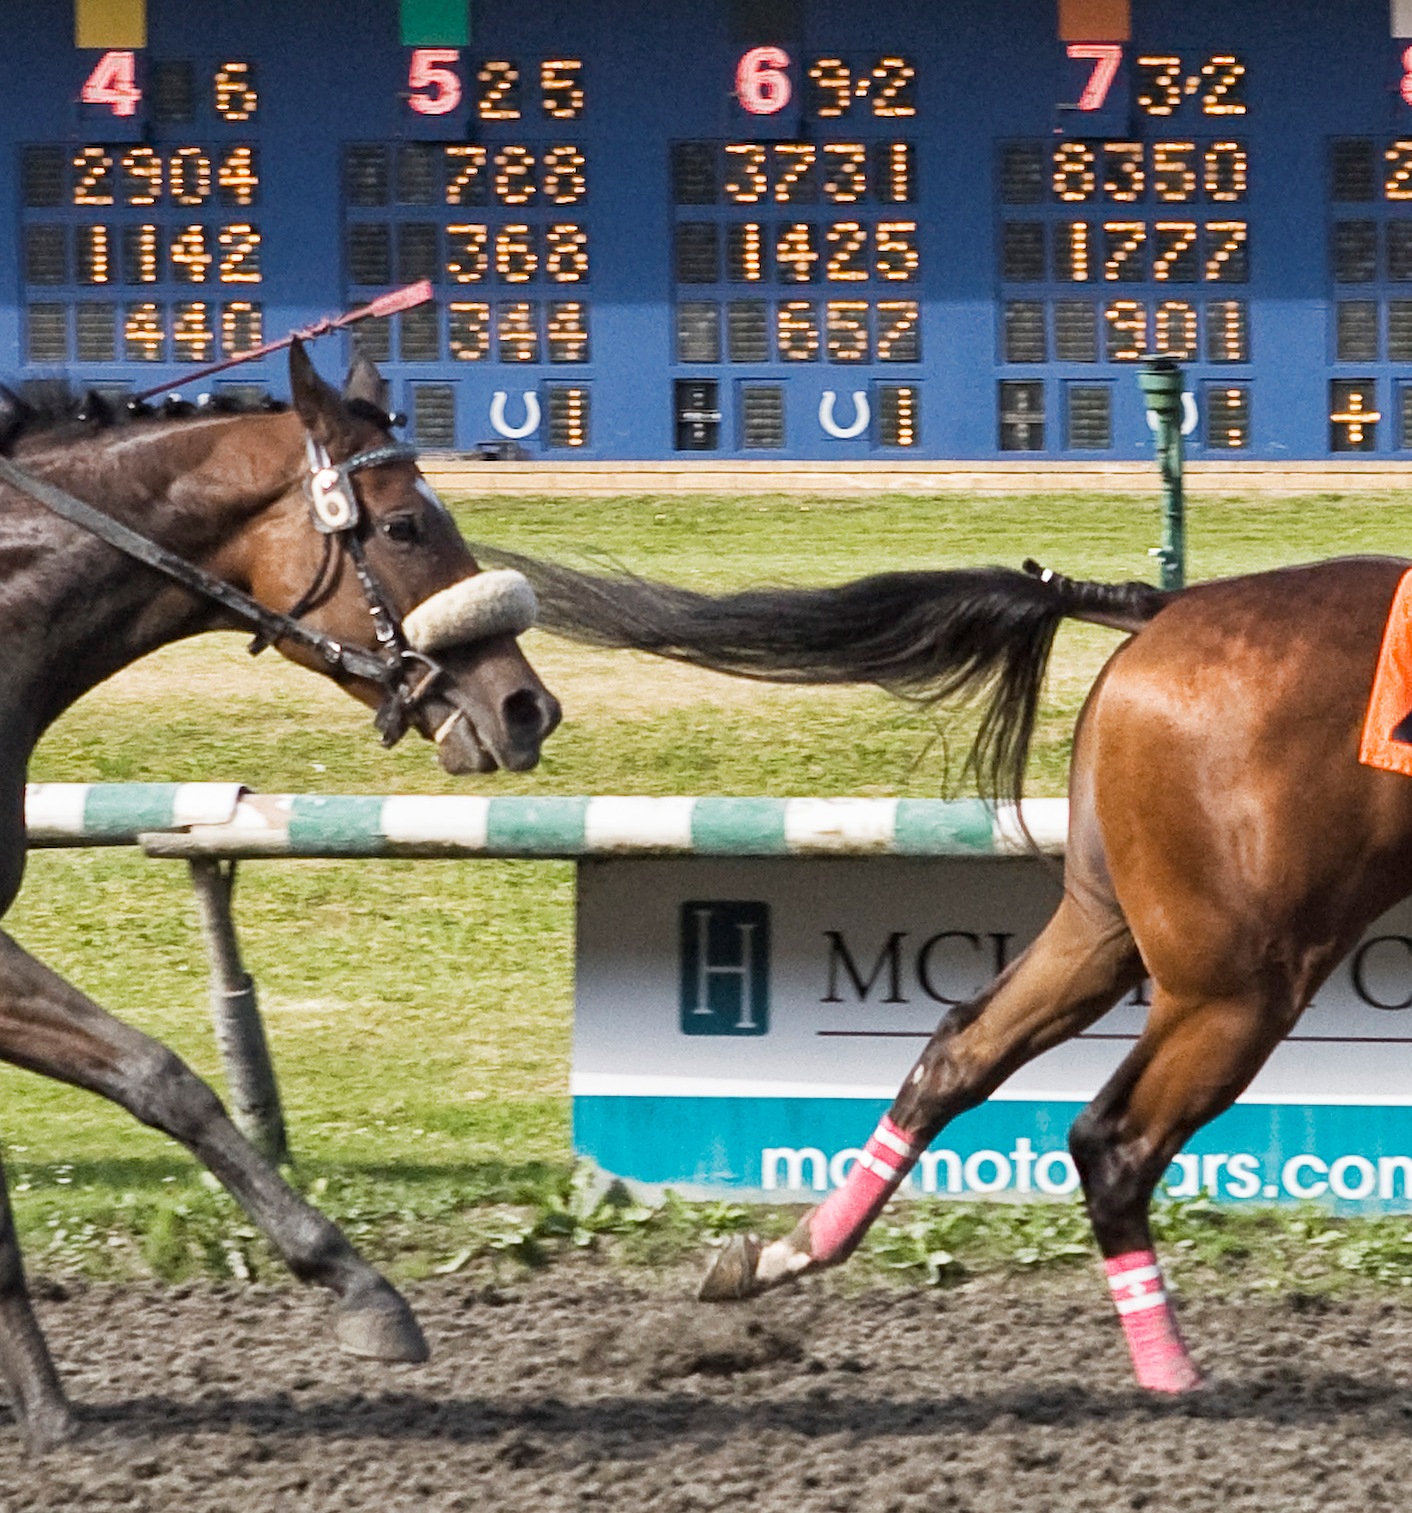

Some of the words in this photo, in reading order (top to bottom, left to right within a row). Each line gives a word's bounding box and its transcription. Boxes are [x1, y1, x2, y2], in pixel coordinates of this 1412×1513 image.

[83, 52, 142, 118] 4
[216, 64, 258, 121] 6
[409, 49, 462, 116] 5
[736, 47, 792, 116] 6
[1067, 45, 1124, 112] 7
[74, 148, 260, 206] 2904
[726, 144, 909, 203] 3731
[1054, 143, 1248, 203] 8350
[93, 225, 263, 284] 1142
[447, 225, 589, 284] 368
[743, 223, 919, 282] 1425
[1072, 222, 1248, 282] 1777
[125, 303, 263, 363] 440
[451, 303, 588, 361] 344
[778, 302, 919, 360] 657
[1105, 302, 1242, 361] 901
[311, 466, 350, 528] 6
